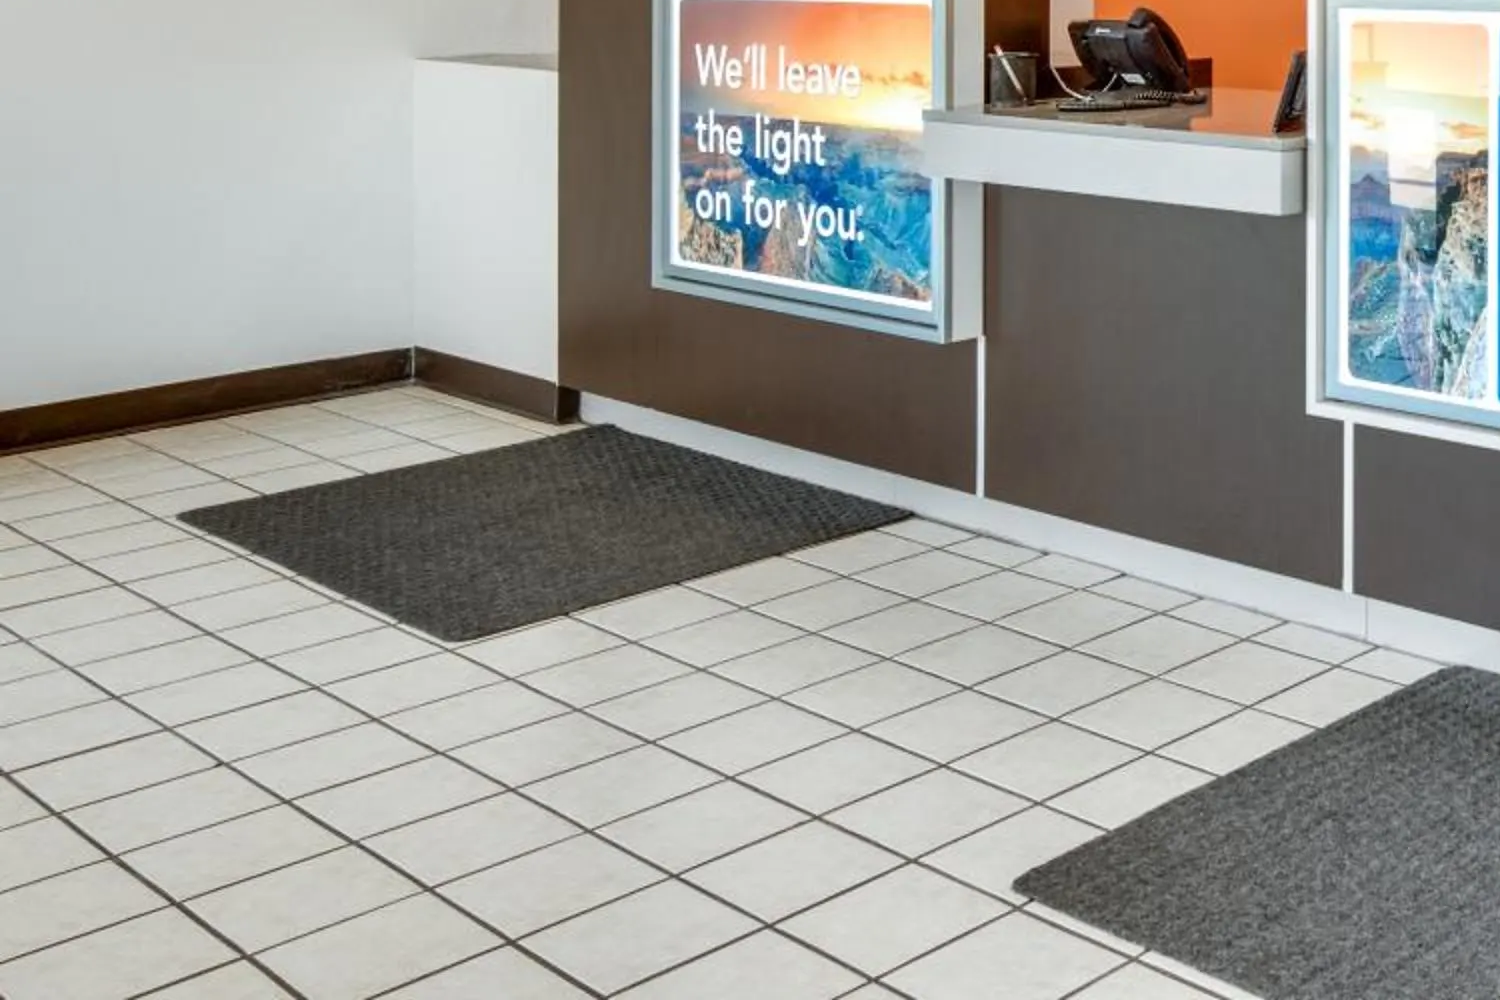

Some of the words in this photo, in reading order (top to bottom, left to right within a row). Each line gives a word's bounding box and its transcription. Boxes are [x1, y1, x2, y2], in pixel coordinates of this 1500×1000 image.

[695, 43, 767, 90] We'll
[779, 45, 862, 96] leave
[695, 108, 743, 157] the
[754, 113, 826, 175] light
[695, 188, 732, 222] on
[742, 179, 788, 229] for
